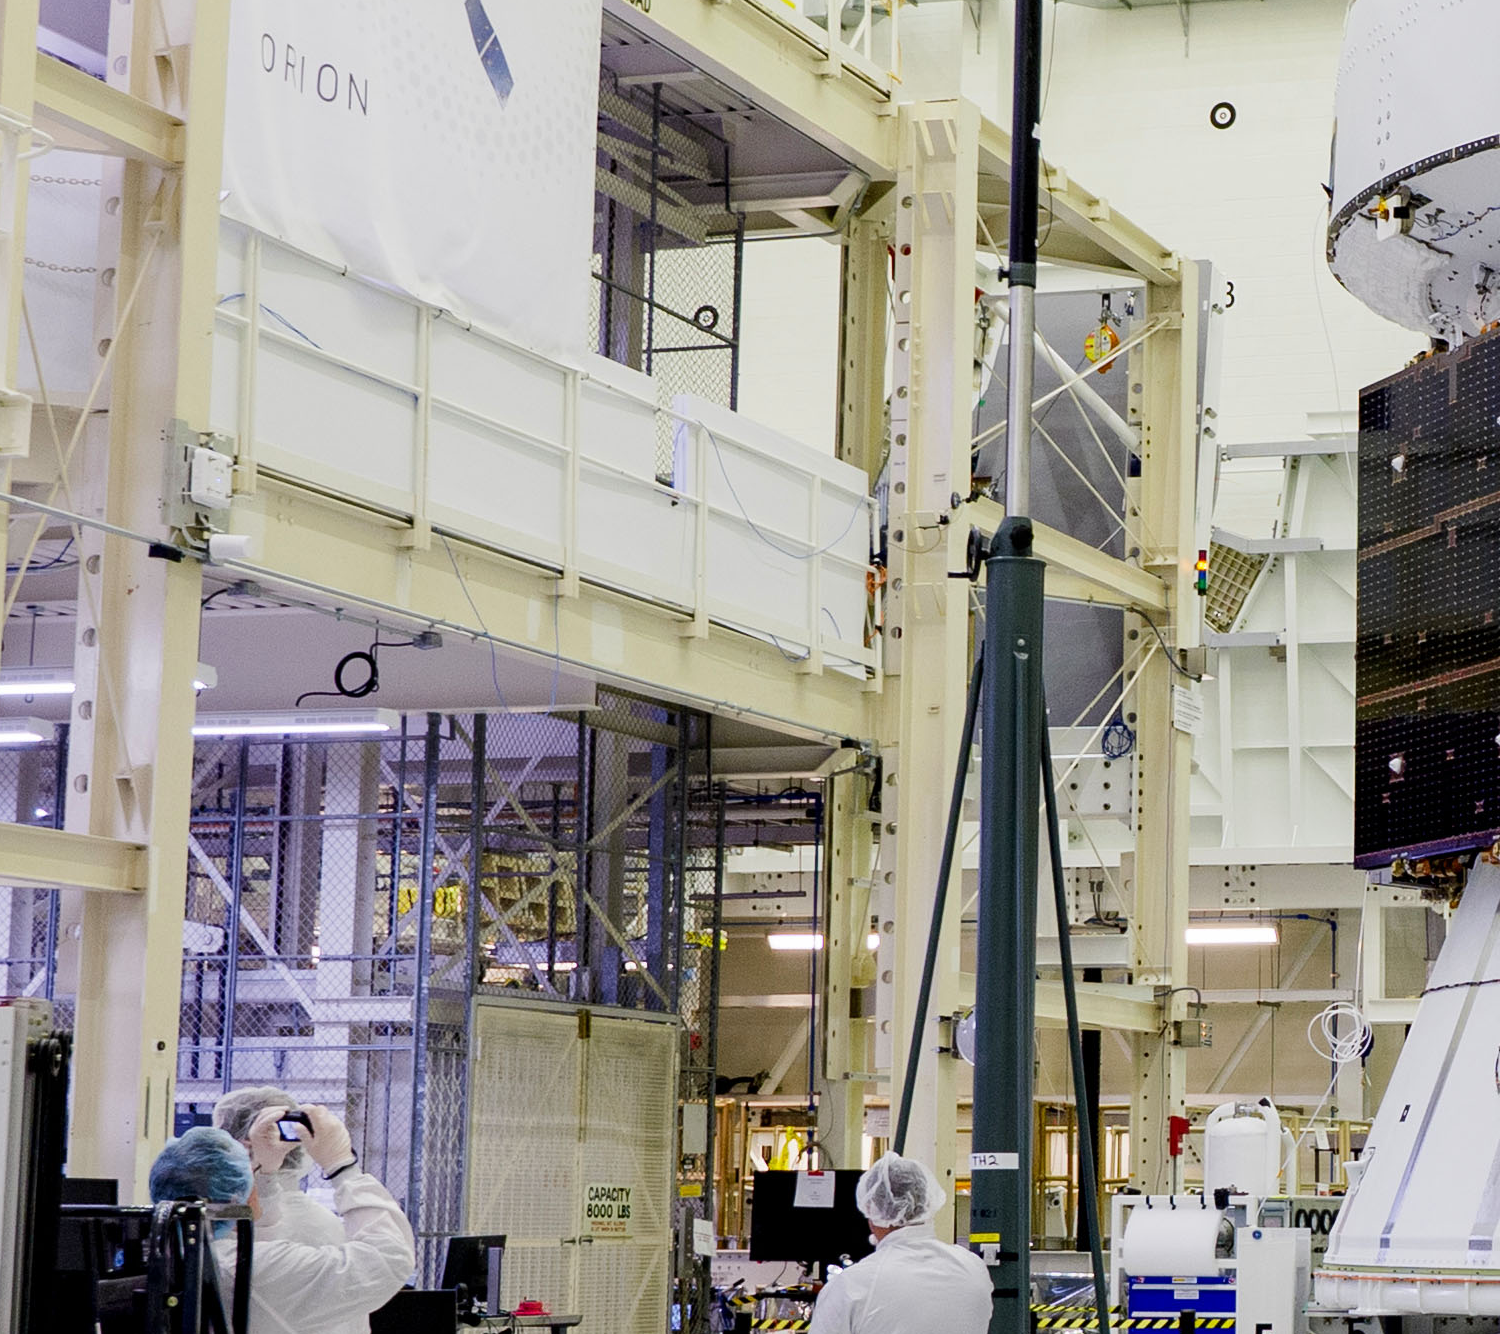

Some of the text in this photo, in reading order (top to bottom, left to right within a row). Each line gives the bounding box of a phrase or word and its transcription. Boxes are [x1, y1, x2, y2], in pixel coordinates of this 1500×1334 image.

[261, 33, 370, 116] ORION
[972, 1154, 999, 1166] TH2
[588, 1187, 631, 1202] CAPACITY
[586, 1204, 631, 1219] 8000 LBS
